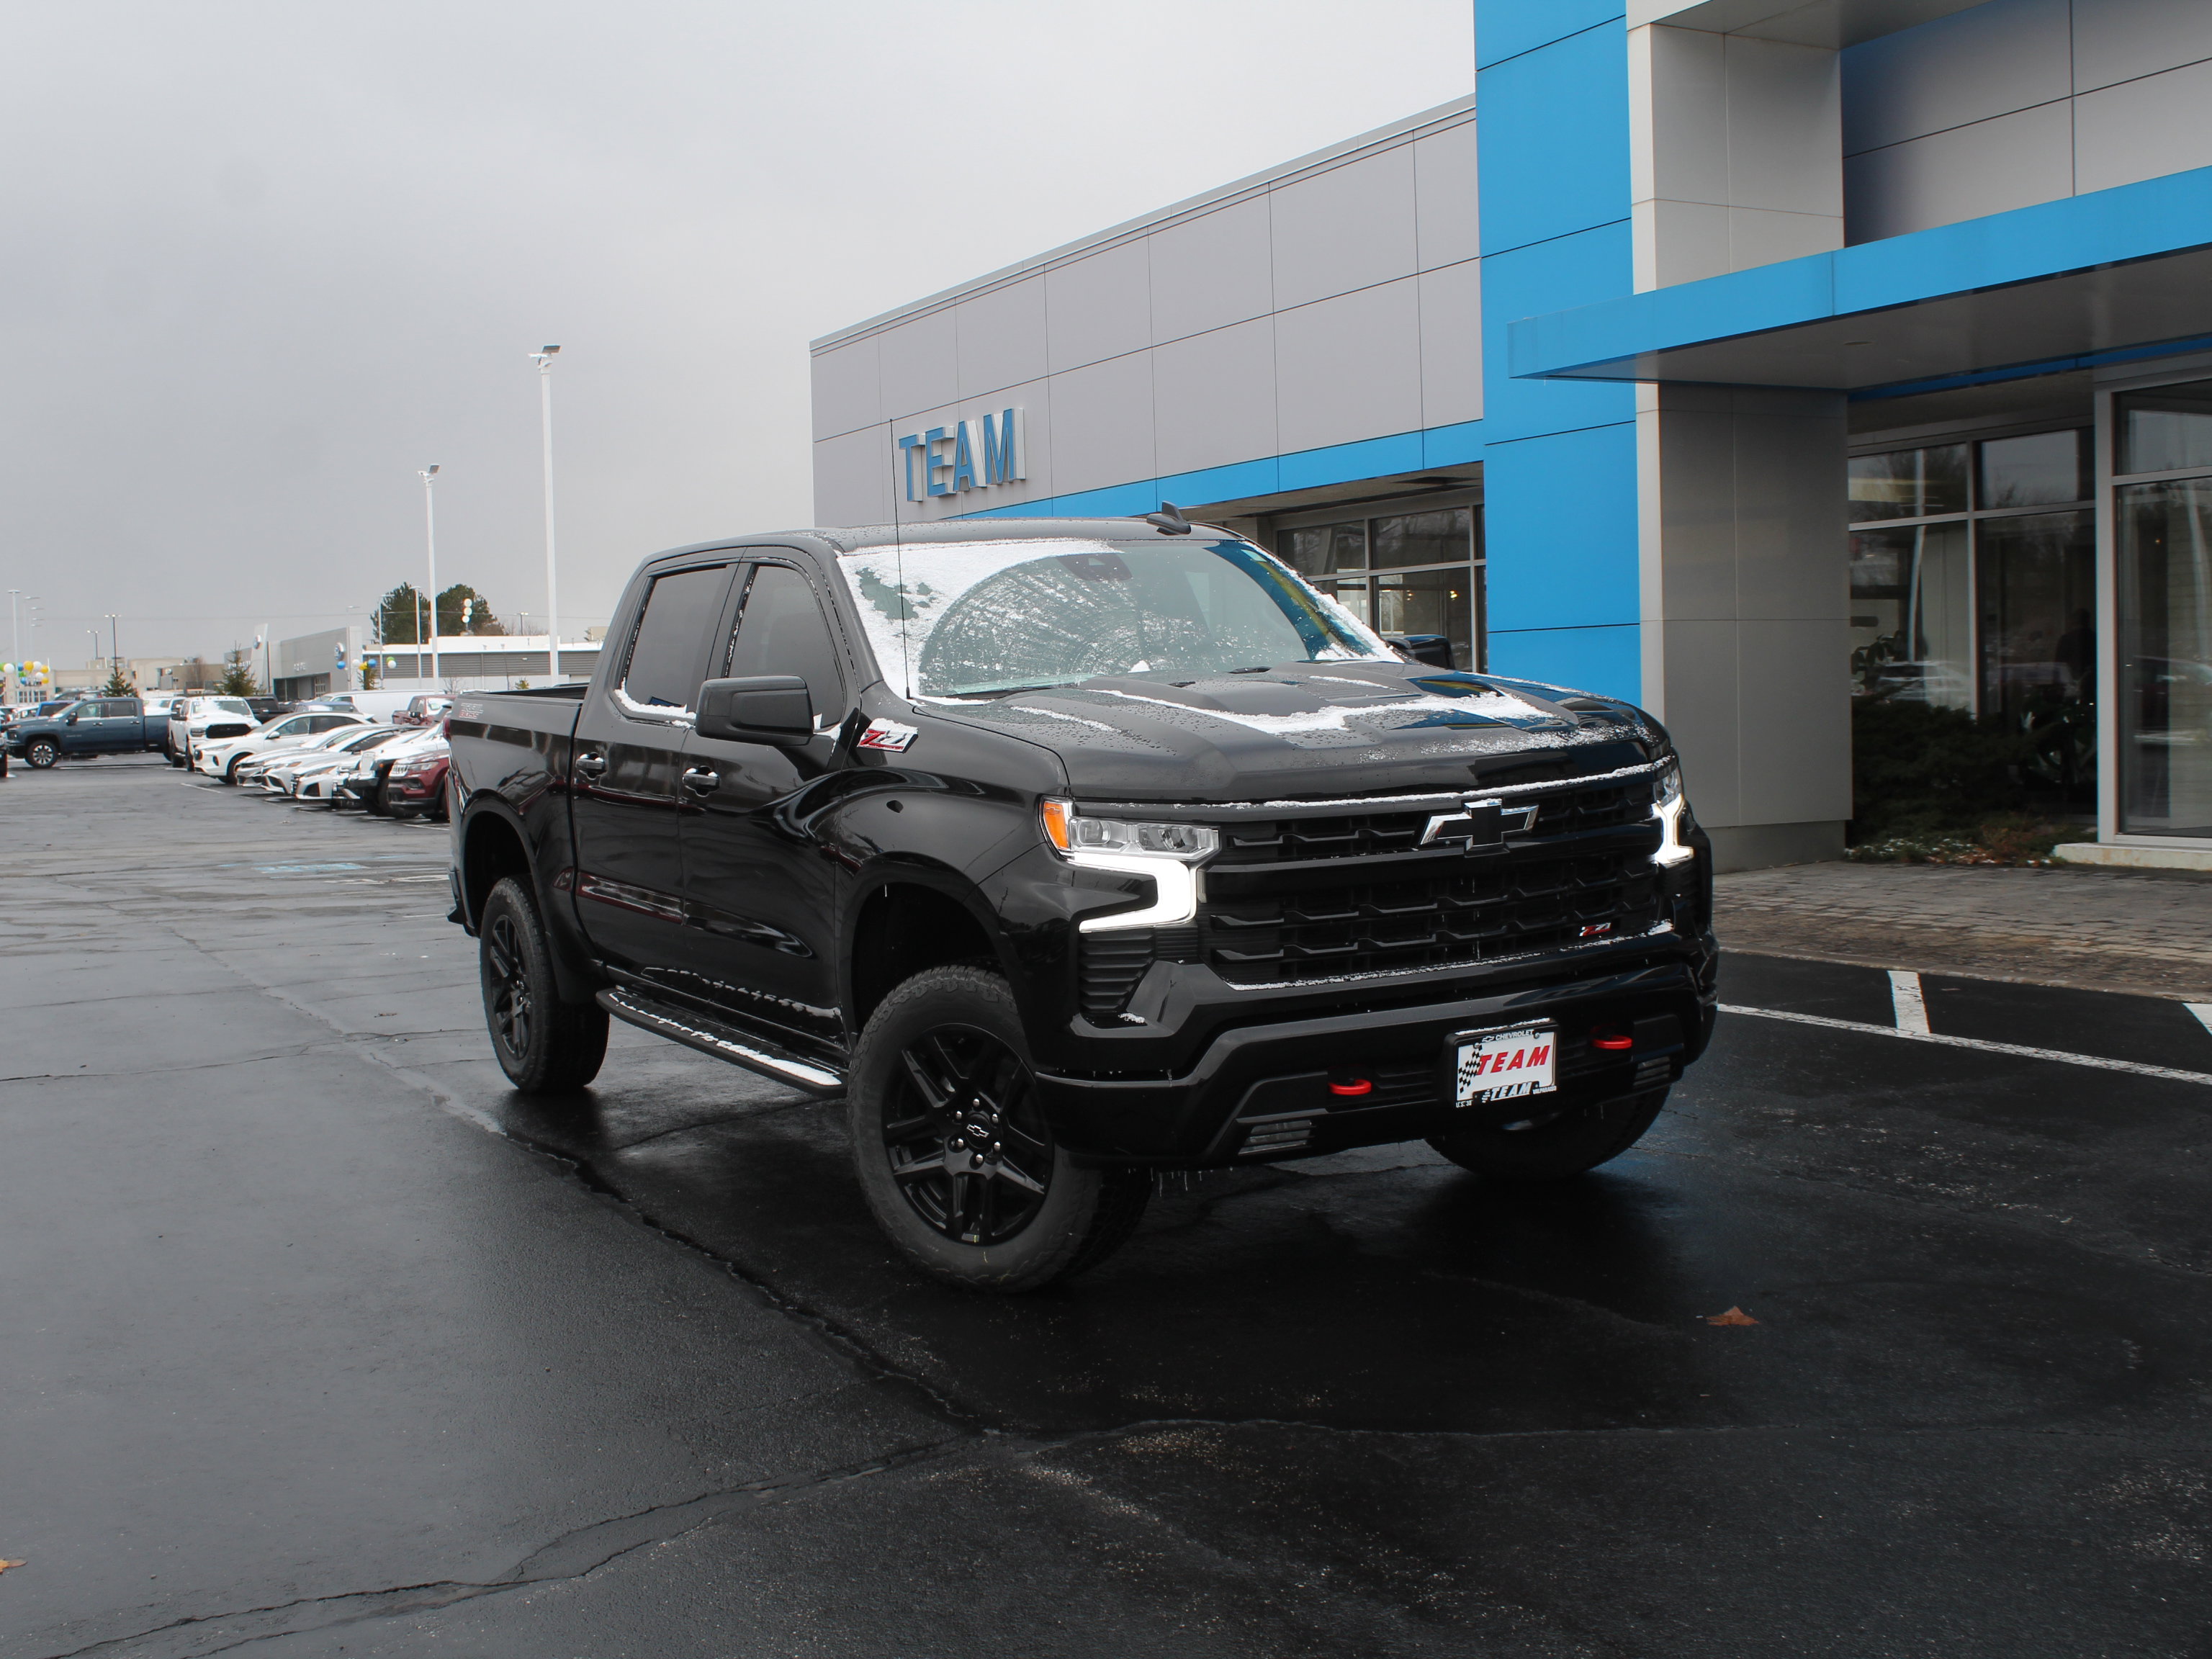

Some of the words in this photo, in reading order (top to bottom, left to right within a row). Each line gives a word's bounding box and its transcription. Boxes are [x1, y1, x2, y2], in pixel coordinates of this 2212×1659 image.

[899, 408, 1025, 502] TEAM
[1579, 922, 1611, 936] Z71
[1496, 1030, 1534, 1040] CHEVROLET
[1477, 1046, 1550, 1075] TEAM
[1491, 1082, 1532, 1100] TEAM
